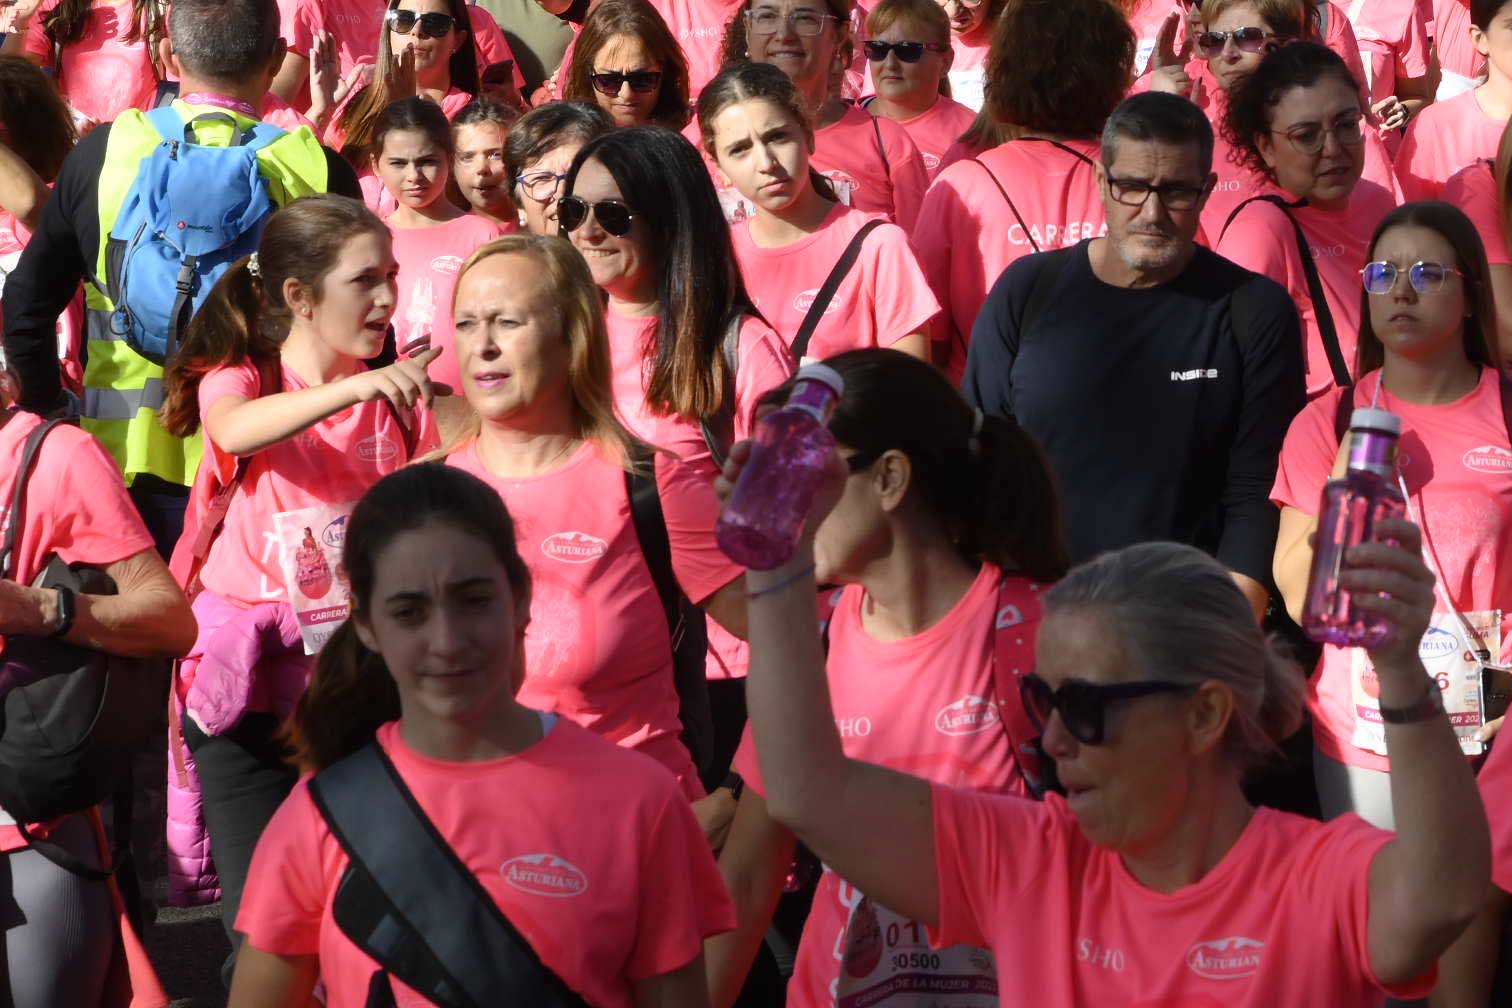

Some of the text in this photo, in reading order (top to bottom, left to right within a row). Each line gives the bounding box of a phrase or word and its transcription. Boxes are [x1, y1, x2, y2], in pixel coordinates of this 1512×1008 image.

[1170, 368, 1217, 380] INSIDE
[546, 539, 606, 558] ASTURIANA
[509, 865, 582, 892] ASTURIANA
